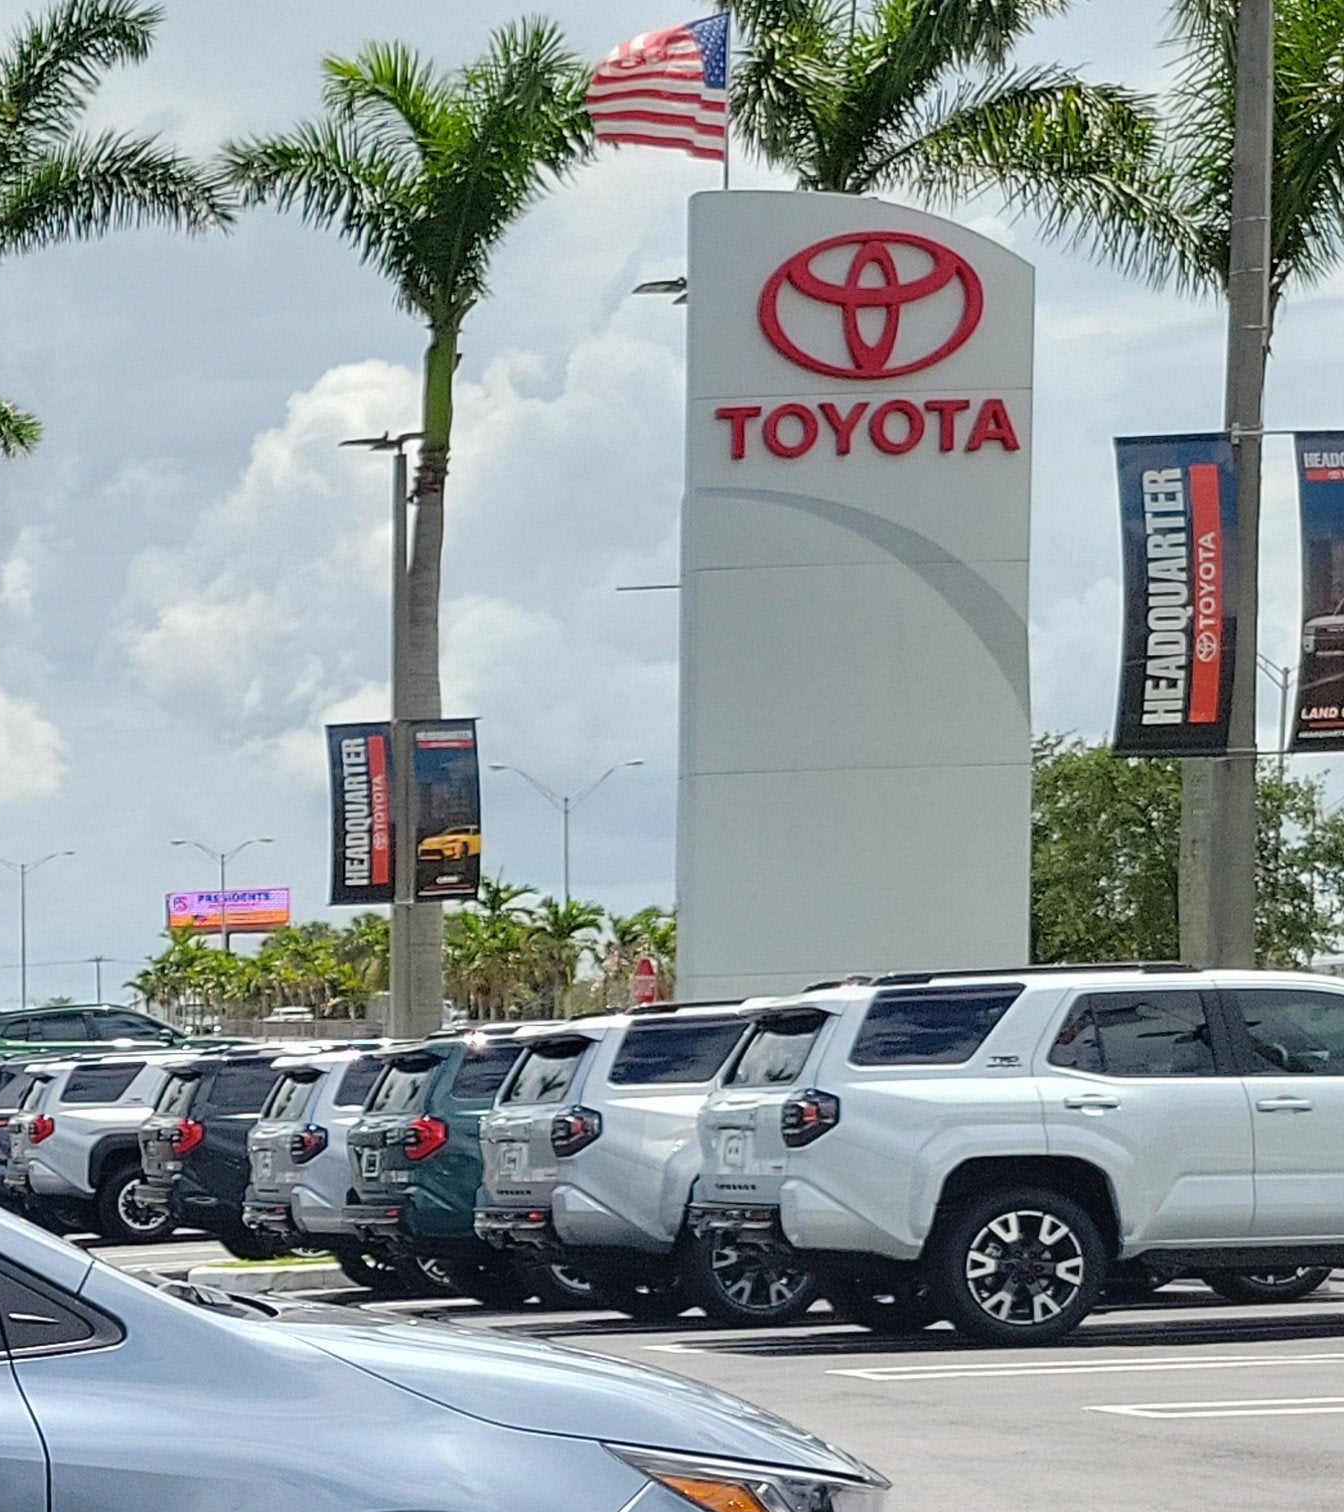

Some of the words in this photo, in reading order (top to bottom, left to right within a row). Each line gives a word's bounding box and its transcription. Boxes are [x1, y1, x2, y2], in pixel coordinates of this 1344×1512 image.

[715, 398, 1021, 460] TOYOTA
[1141, 467, 1193, 726] HEADQUARTER
[1197, 531, 1218, 629] TOYOTA
[1301, 706, 1339, 719] LAND
[341, 737, 373, 887] HEADQUARTER
[372, 774, 388, 836] TOYOTA
